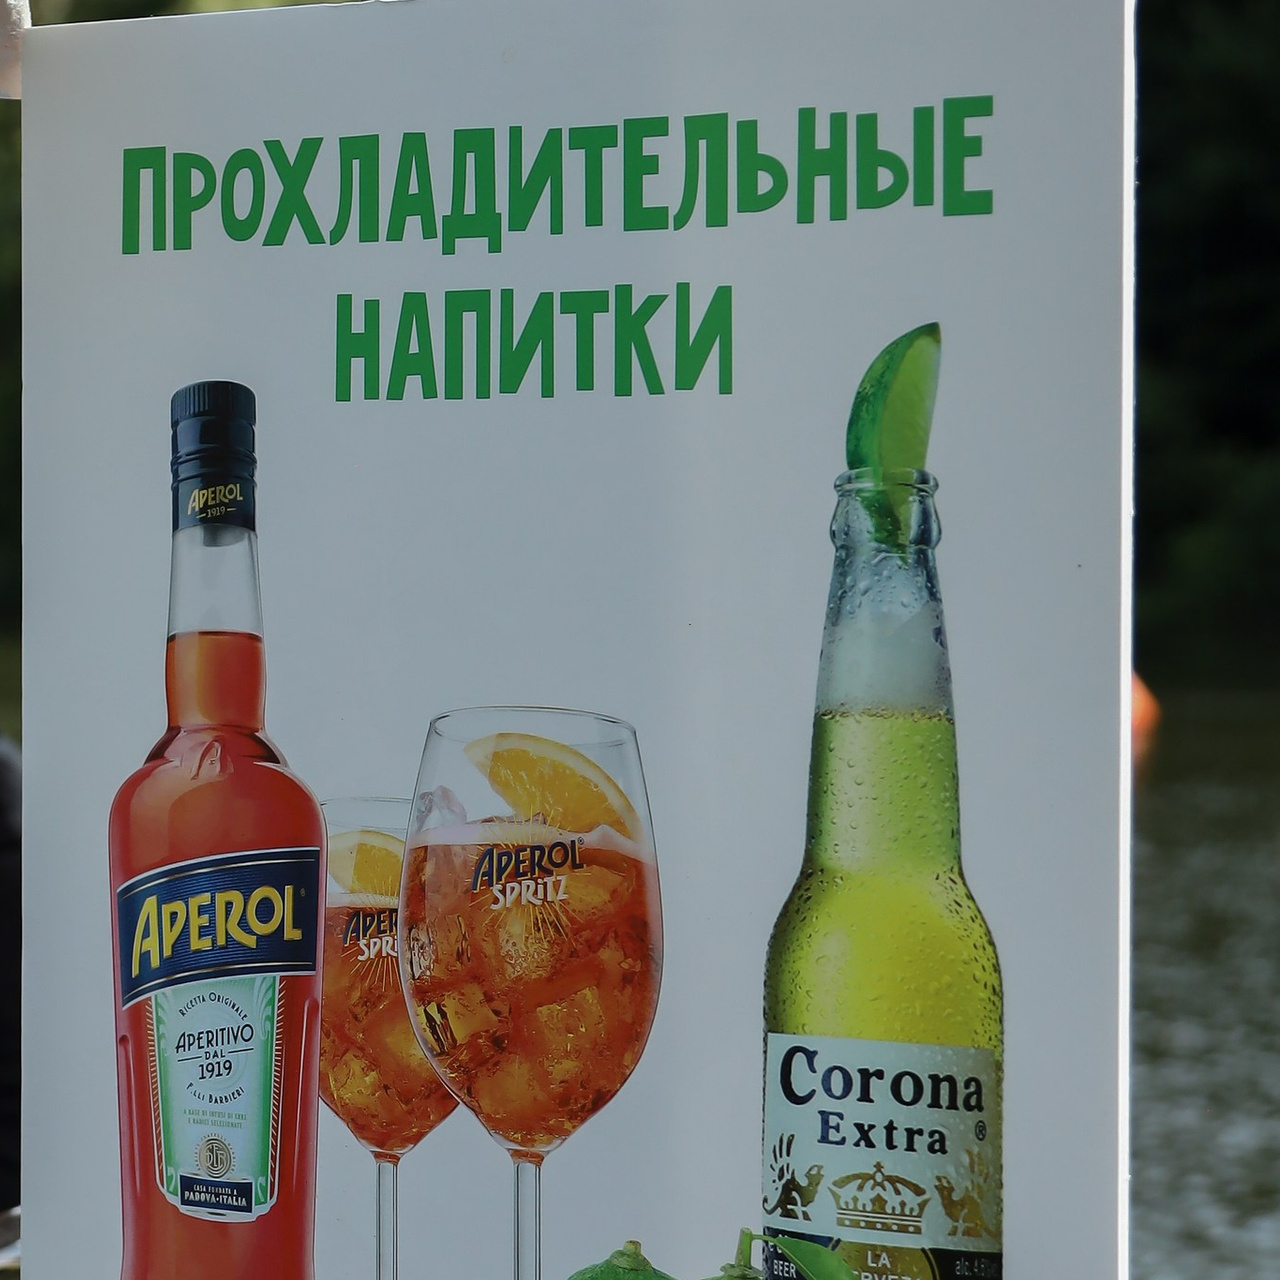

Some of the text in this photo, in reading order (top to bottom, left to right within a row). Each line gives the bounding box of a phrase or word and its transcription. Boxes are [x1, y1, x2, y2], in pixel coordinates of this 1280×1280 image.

[121, 94, 994, 256] ПРОХЛАДИТЕЛЬНЫЕ
[334, 281, 733, 403] НАПИТКИ
[187, 483, 243, 515] APEROL
[471, 839, 585, 891] APEROL
[131, 885, 303, 978] APEROL
[343, 908, 398, 947] APER
[178, 992, 248, 1021] RICETTA ORIGINALE
[175, 1023, 255, 1054] APERITIVO
[204, 1049, 226, 1061] DAL
[198, 1059, 233, 1080] 1919
[780, 1045, 985, 1113] Corona
[208, 1086, 245, 1105] BARBIERI
[817, 1109, 949, 1155] Extra
[867, 1251, 891, 1269] LA
